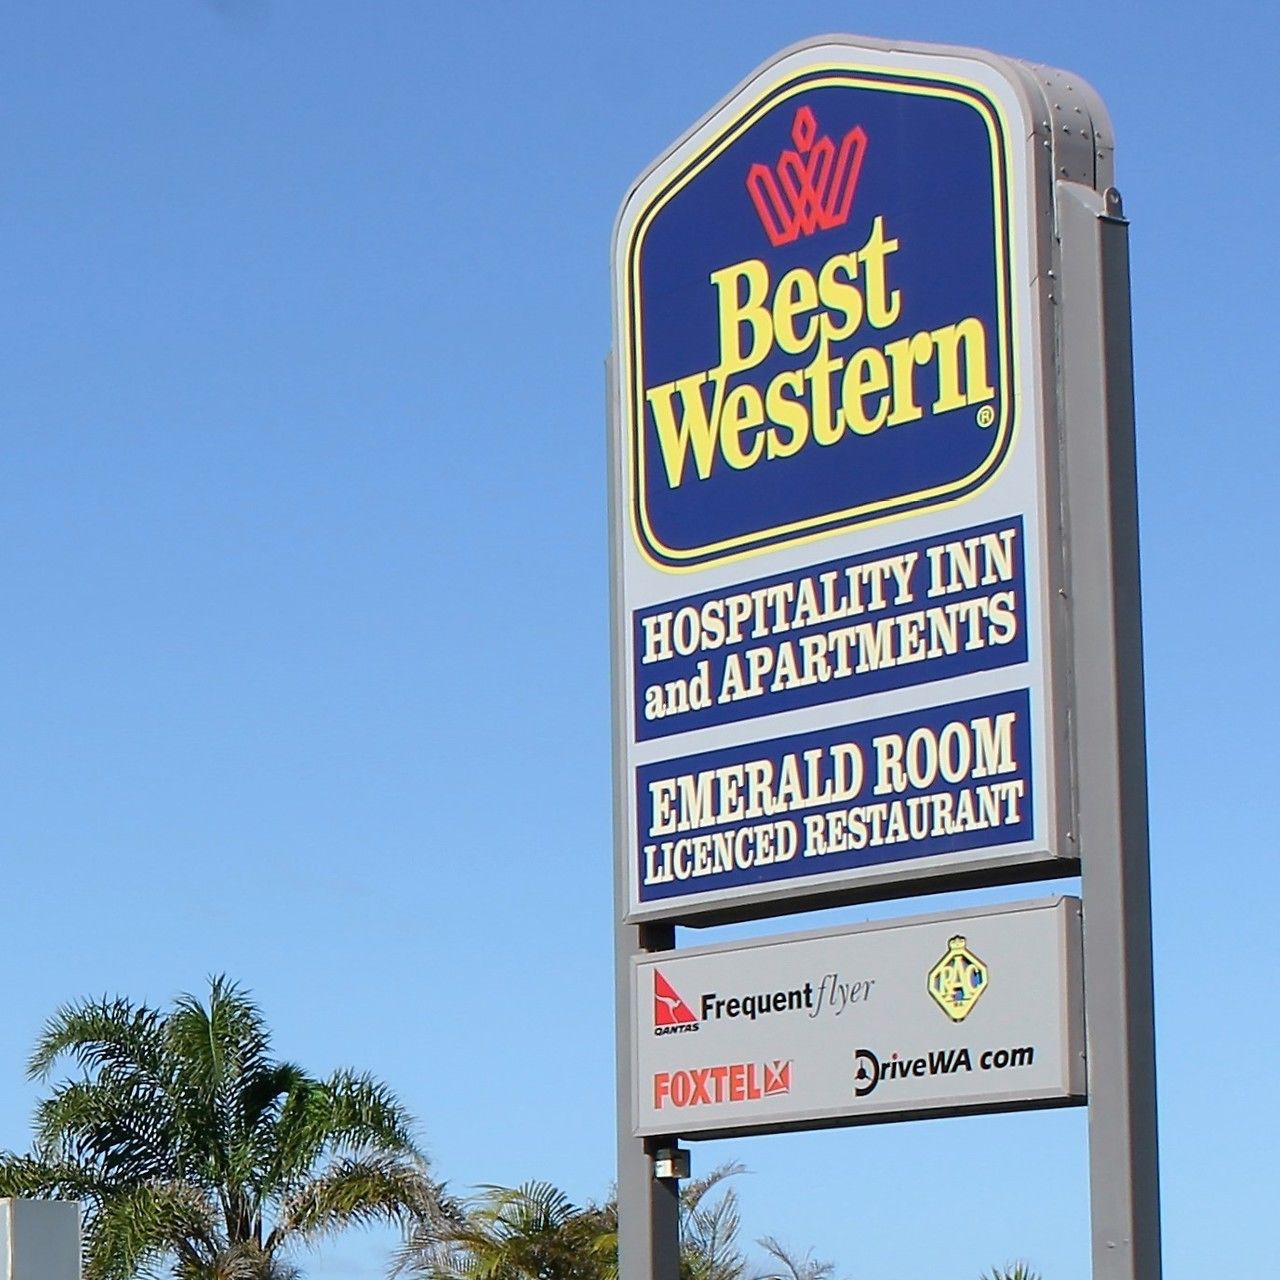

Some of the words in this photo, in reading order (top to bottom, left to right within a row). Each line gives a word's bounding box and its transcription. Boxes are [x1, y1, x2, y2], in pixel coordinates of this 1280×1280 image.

[710, 216, 900, 375] Best
[646, 315, 994, 488] Western
[641, 553, 918, 663] HOSPITALITY
[925, 529, 1016, 598] INN
[644, 661, 713, 721] and
[717, 590, 1017, 704] APARTMENTS
[642, 820, 798, 886] LICENCED
[802, 779, 1024, 858] RESTAURANT
[648, 741, 864, 837] EMERALD
[872, 712, 1017, 796] ROOM
[654, 1022, 700, 1037] QANTAS
[700, 982, 813, 1021] Frequent
[808, 973, 875, 1020] flyer
[653, 1063, 761, 1110] FOXTEL
